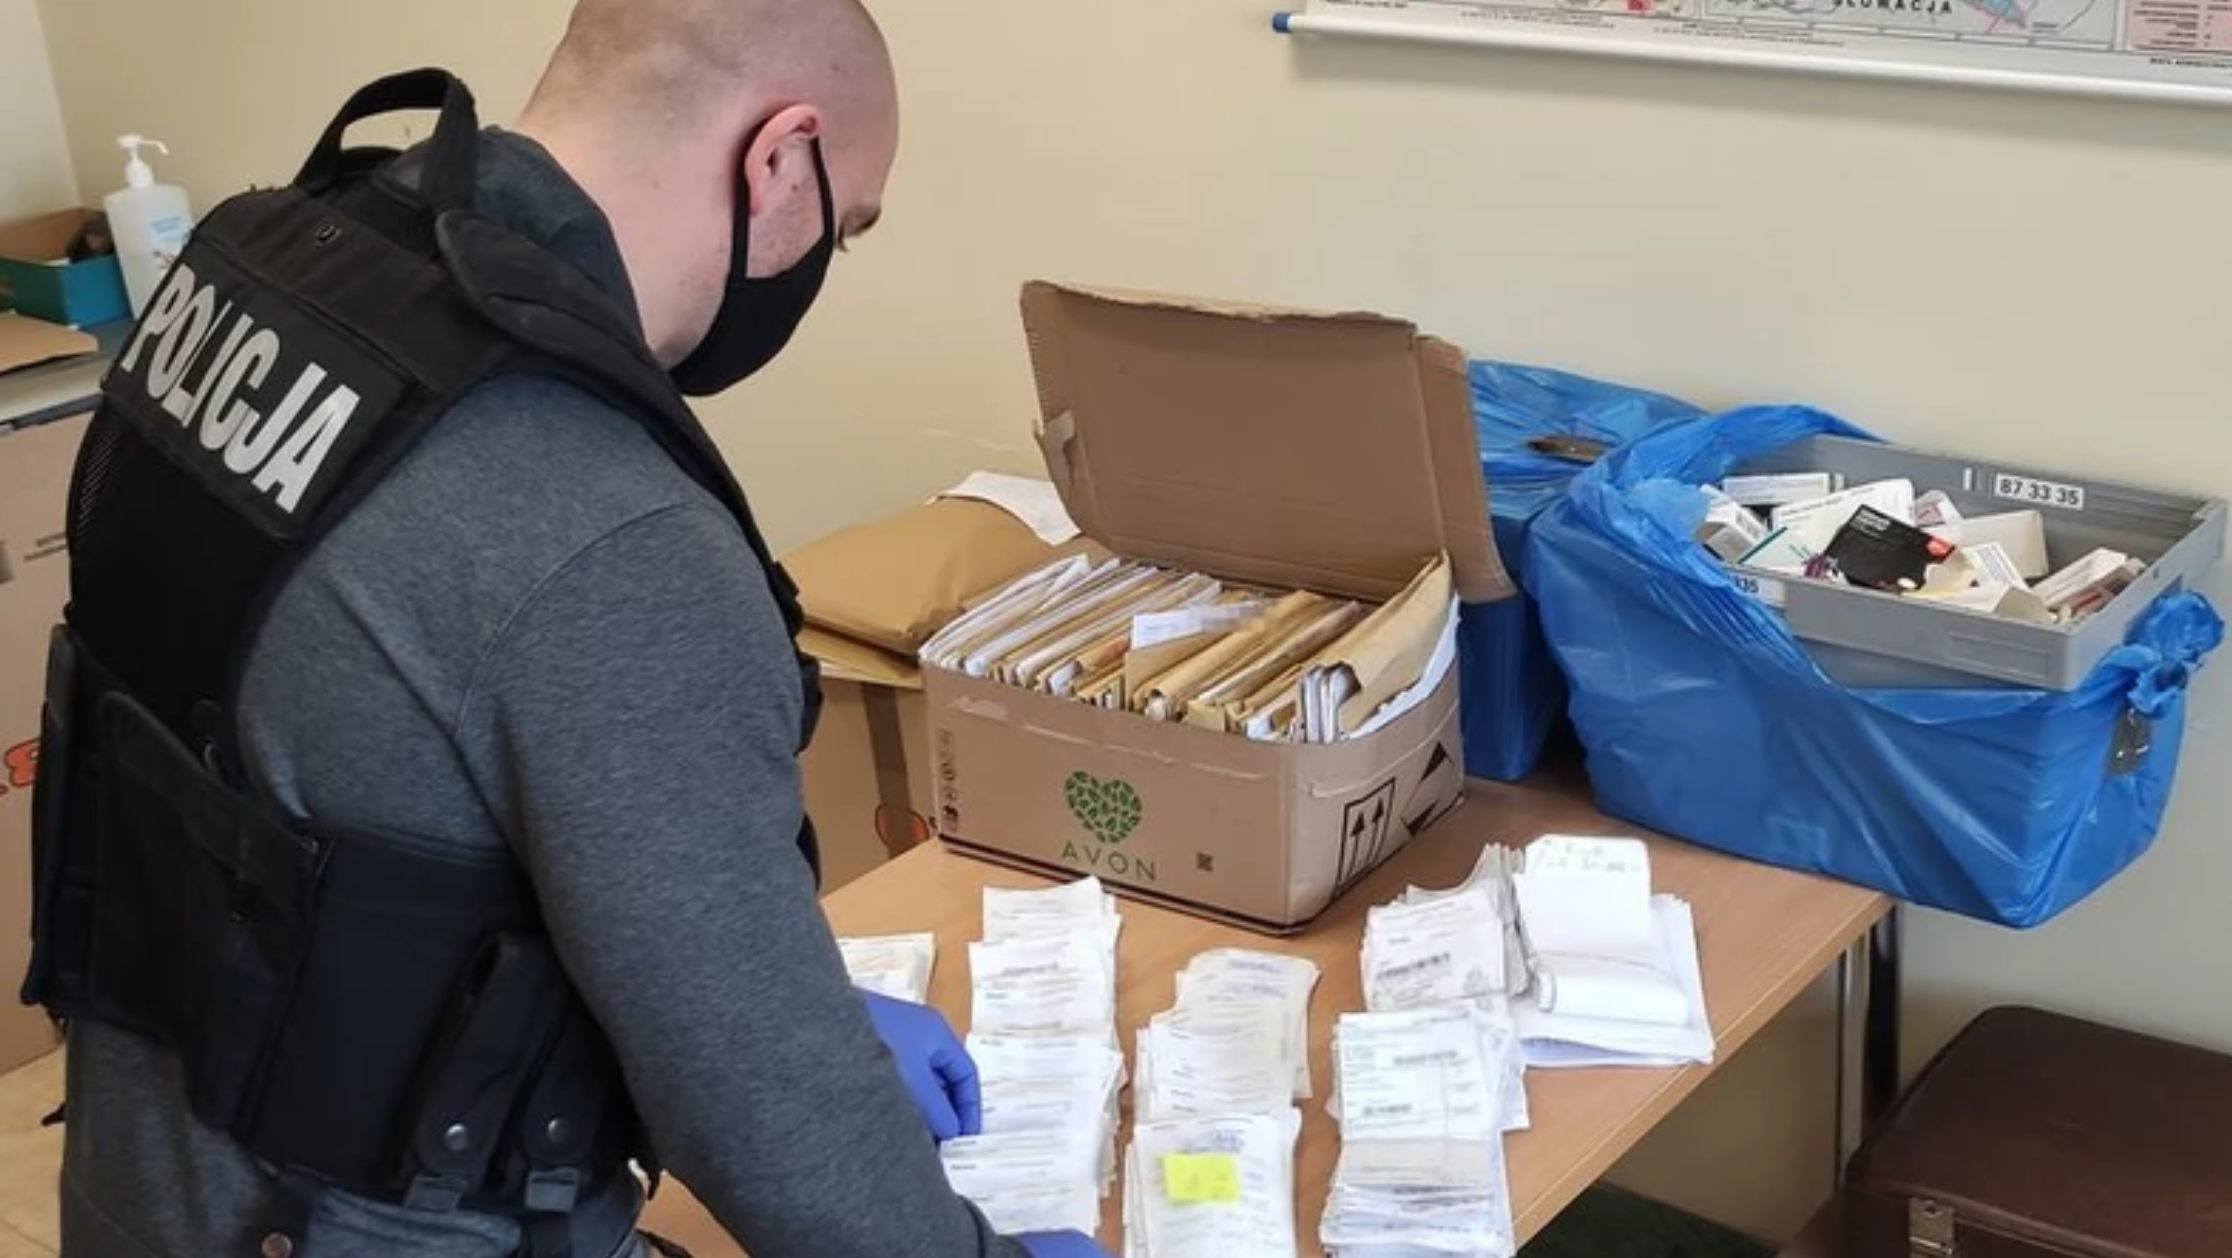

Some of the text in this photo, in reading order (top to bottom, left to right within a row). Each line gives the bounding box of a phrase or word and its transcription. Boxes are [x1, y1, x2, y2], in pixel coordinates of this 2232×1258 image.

[121, 263, 361, 514] POLICJA
[2000, 479, 2080, 505] 87 33 35
[1062, 841, 1157, 881] AVON
